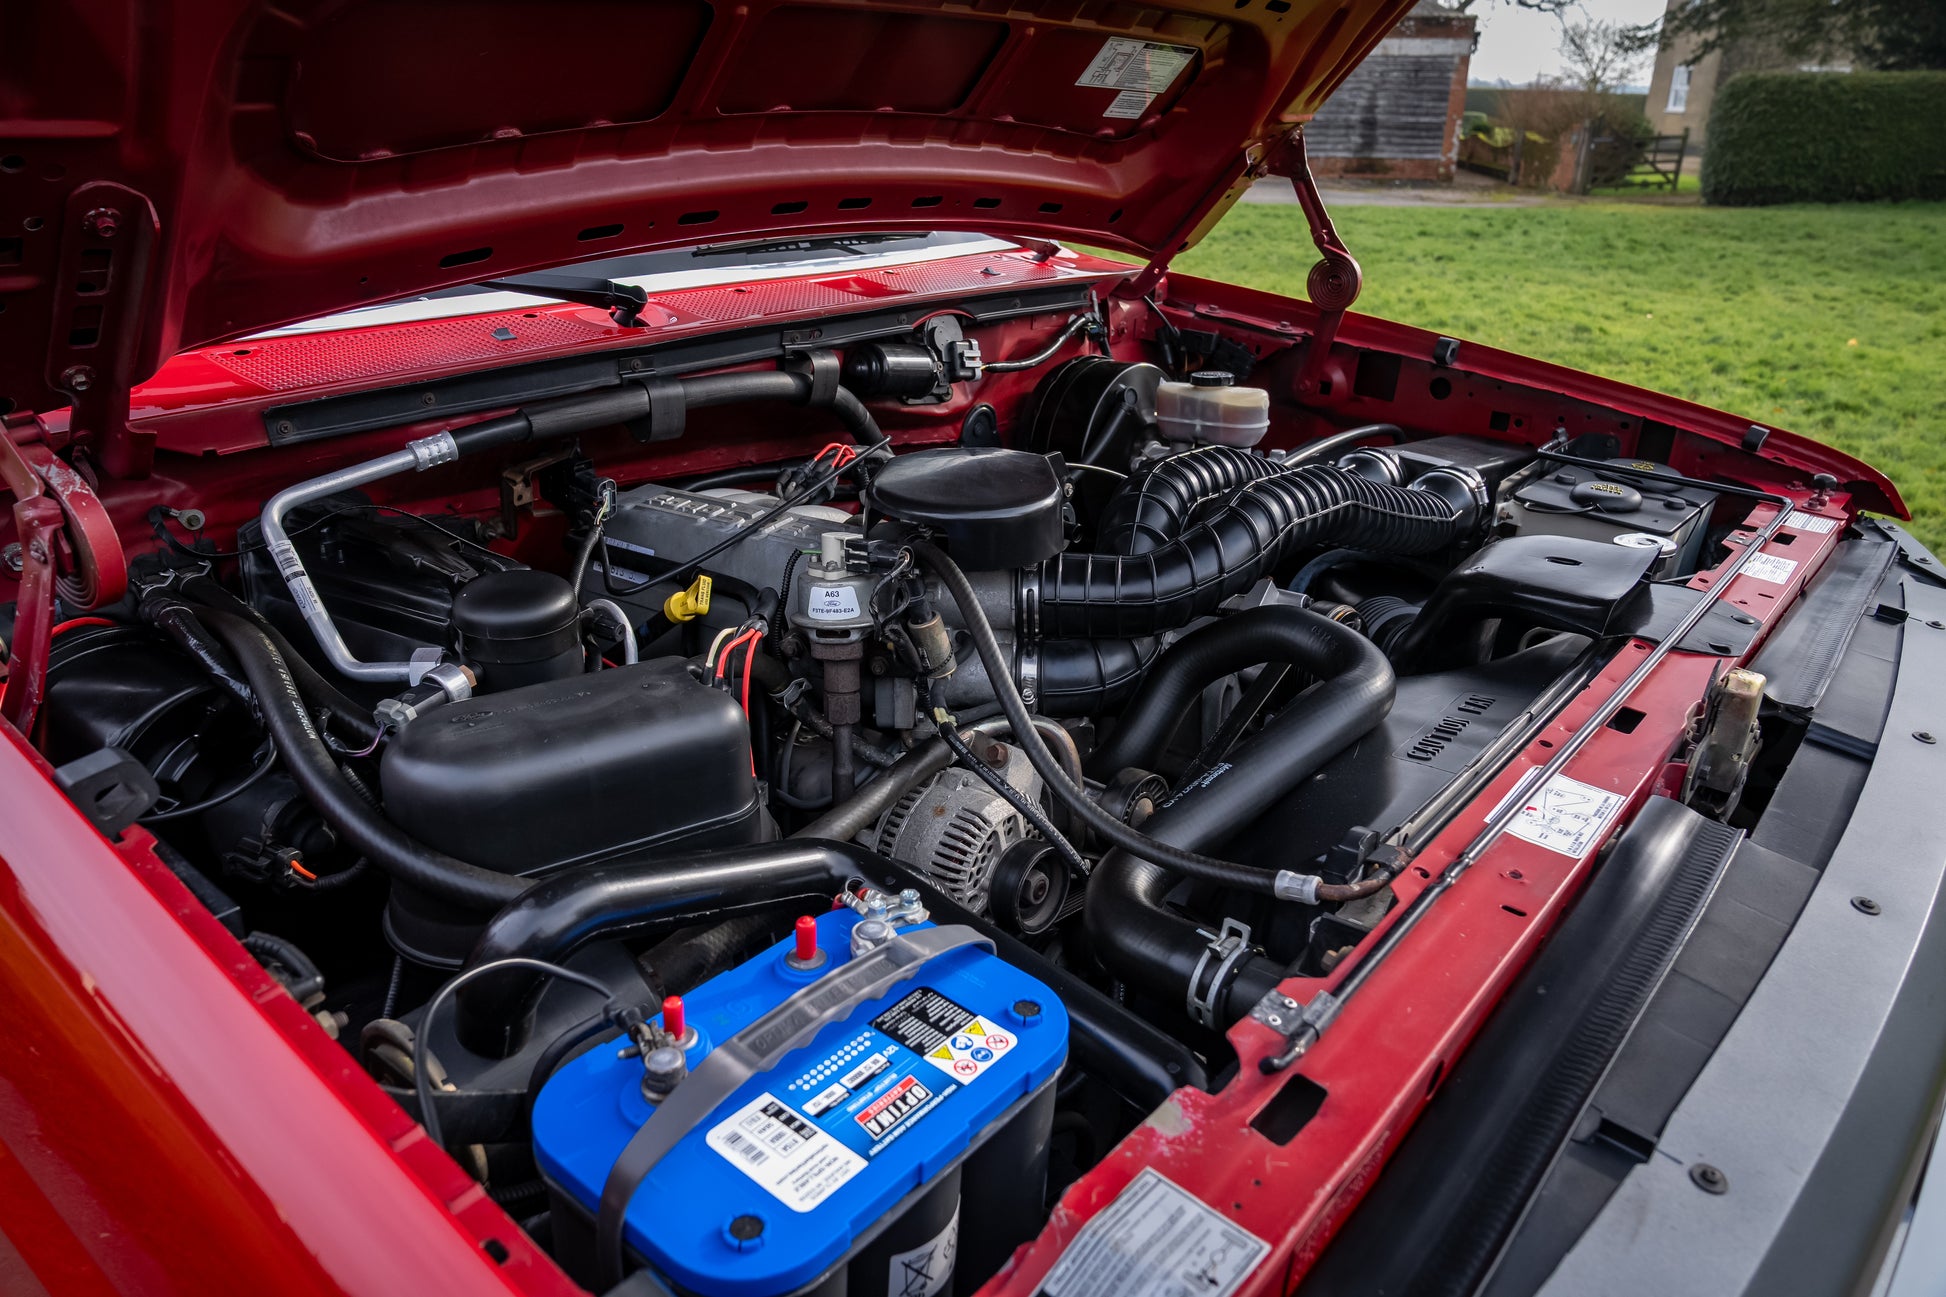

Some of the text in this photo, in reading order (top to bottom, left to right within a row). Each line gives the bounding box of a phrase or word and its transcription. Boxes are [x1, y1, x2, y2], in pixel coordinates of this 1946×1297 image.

[1407, 694, 1496, 761] CAUTION FAN
[883, 1043, 899, 1057] 12V
[863, 1083, 931, 1135] OPTIMA
[866, 1085, 904, 1115] BATTERIES
[866, 1133, 896, 1157] BATTERY
